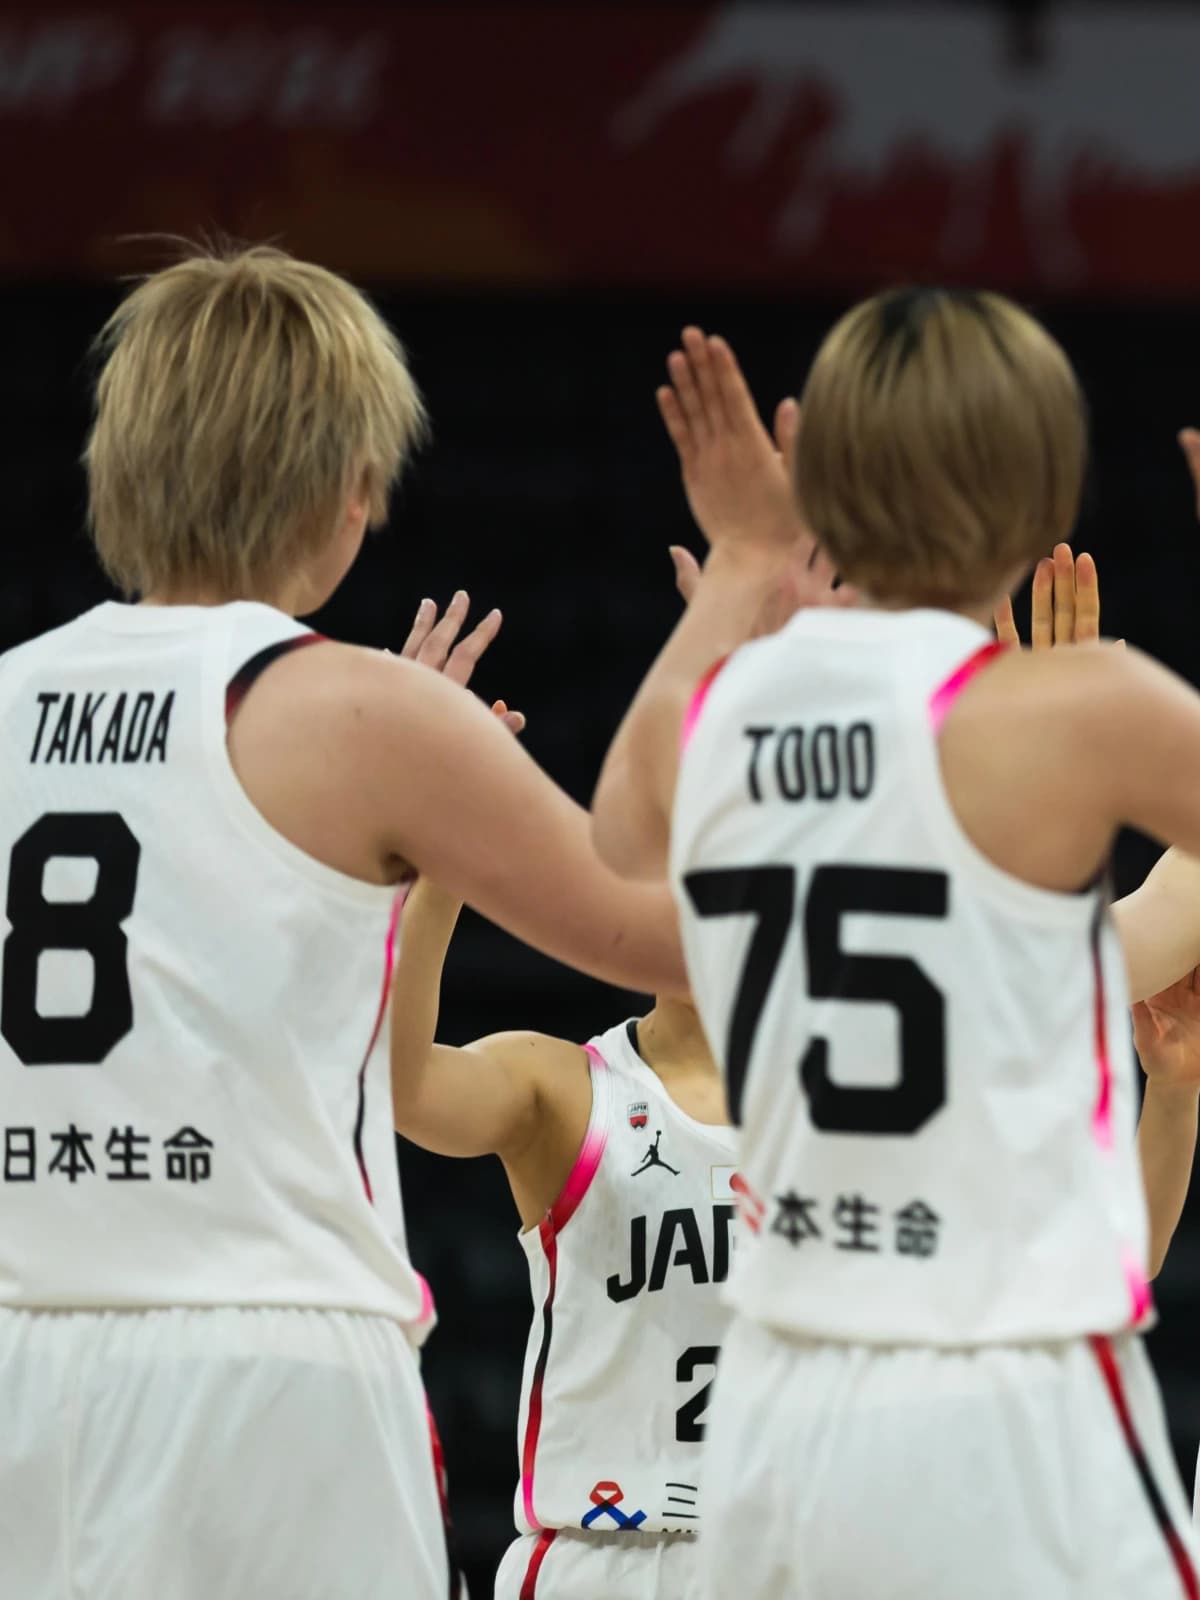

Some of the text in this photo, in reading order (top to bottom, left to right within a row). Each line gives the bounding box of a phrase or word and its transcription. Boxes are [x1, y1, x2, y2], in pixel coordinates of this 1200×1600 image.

[30, 691, 175, 763] TAKADA
[744, 721, 875, 803] TODO
[0, 812, 141, 1066] 8
[682, 864, 949, 1136] 75
[630, 1103, 647, 1112] JAPAN
[3, 1124, 214, 1183] 日本生命
